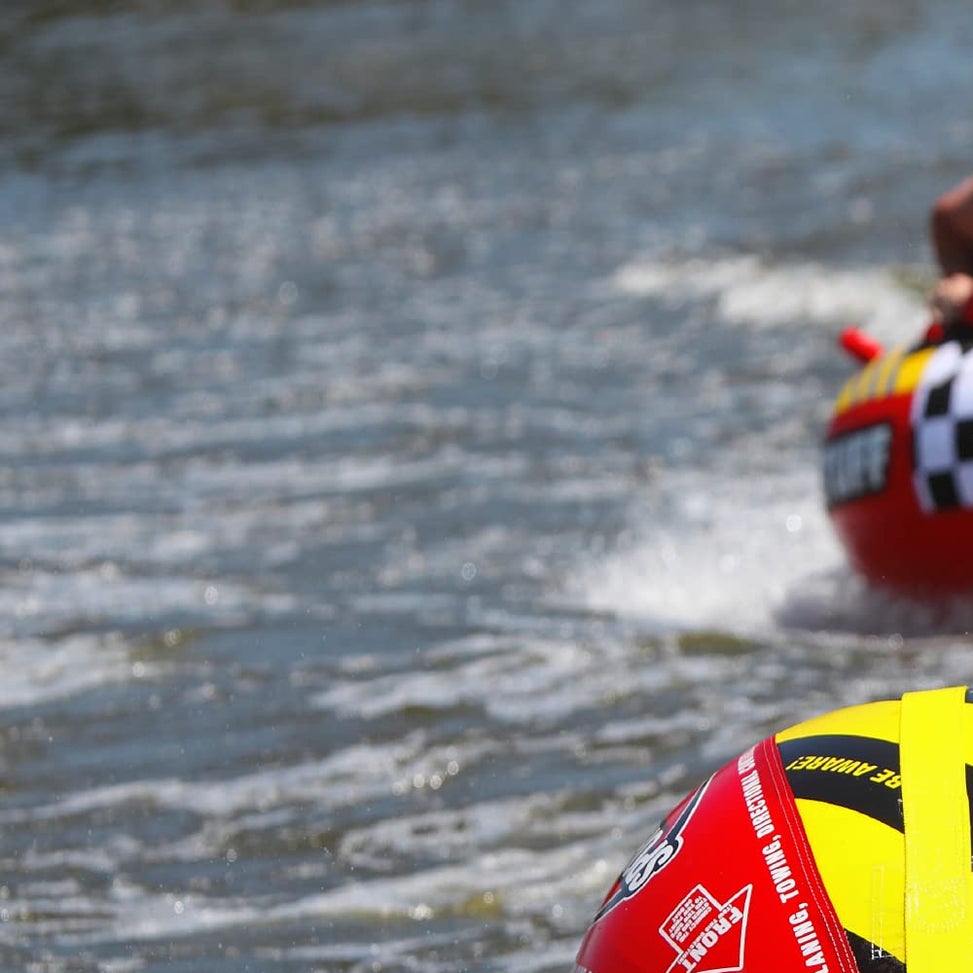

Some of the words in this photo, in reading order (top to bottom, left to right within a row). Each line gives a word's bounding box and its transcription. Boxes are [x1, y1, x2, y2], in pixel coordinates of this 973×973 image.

[784, 755, 878, 777] AWARE!
[869, 768, 903, 789] BE
[761, 834, 800, 904] TOWING,
[681, 906, 743, 973] FRONT
